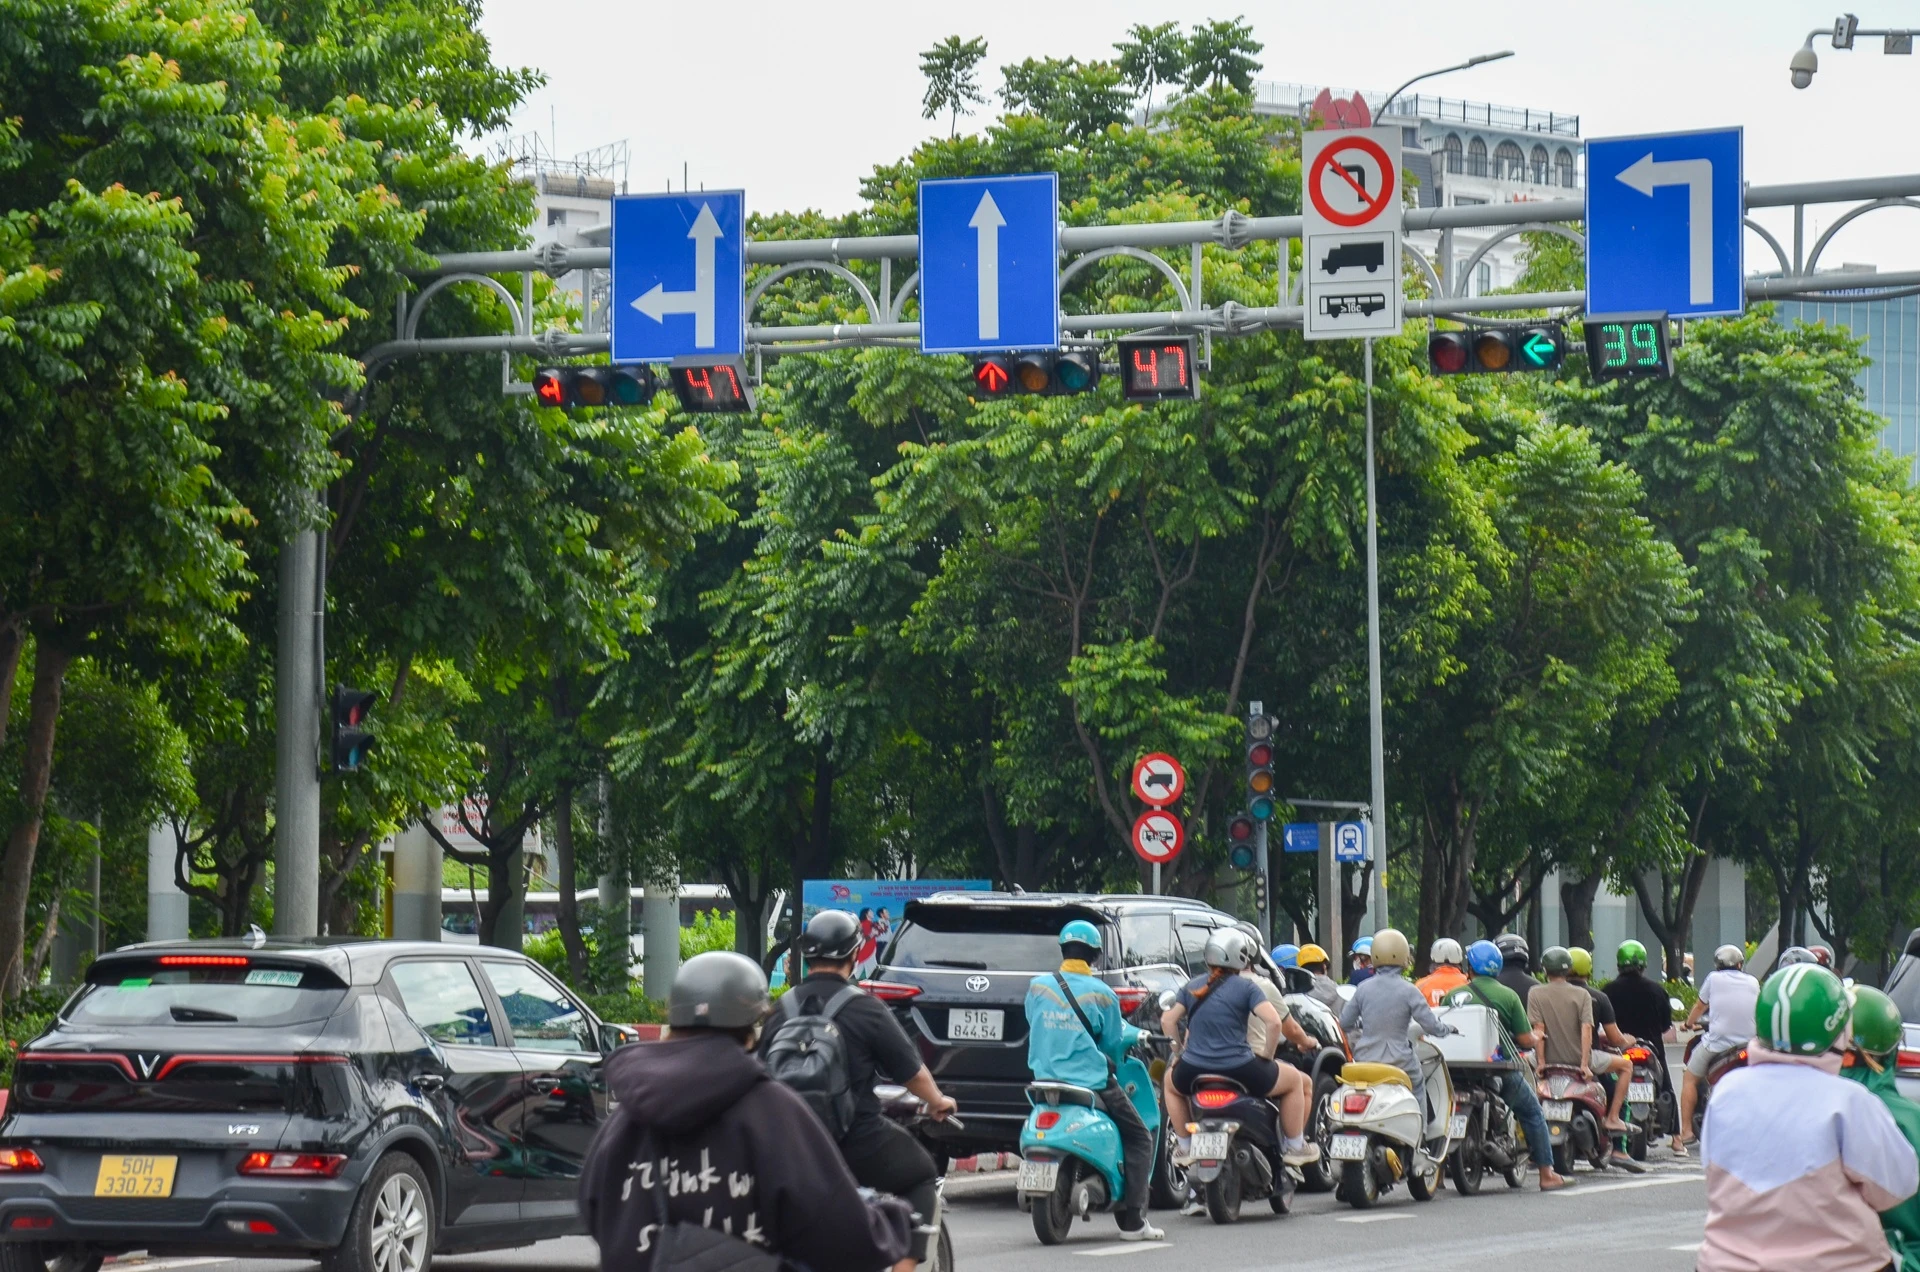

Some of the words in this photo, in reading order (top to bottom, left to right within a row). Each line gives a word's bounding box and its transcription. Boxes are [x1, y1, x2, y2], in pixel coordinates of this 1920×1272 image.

[1602, 323, 1658, 367] 39
[1134, 346, 1185, 387] 47
[685, 365, 740, 400] 47
[964, 1011, 988, 1024] 51G
[954, 1025, 997, 1039] 844.54
[121, 1156, 155, 1175] 50H
[103, 1177, 164, 1195] 330.73
